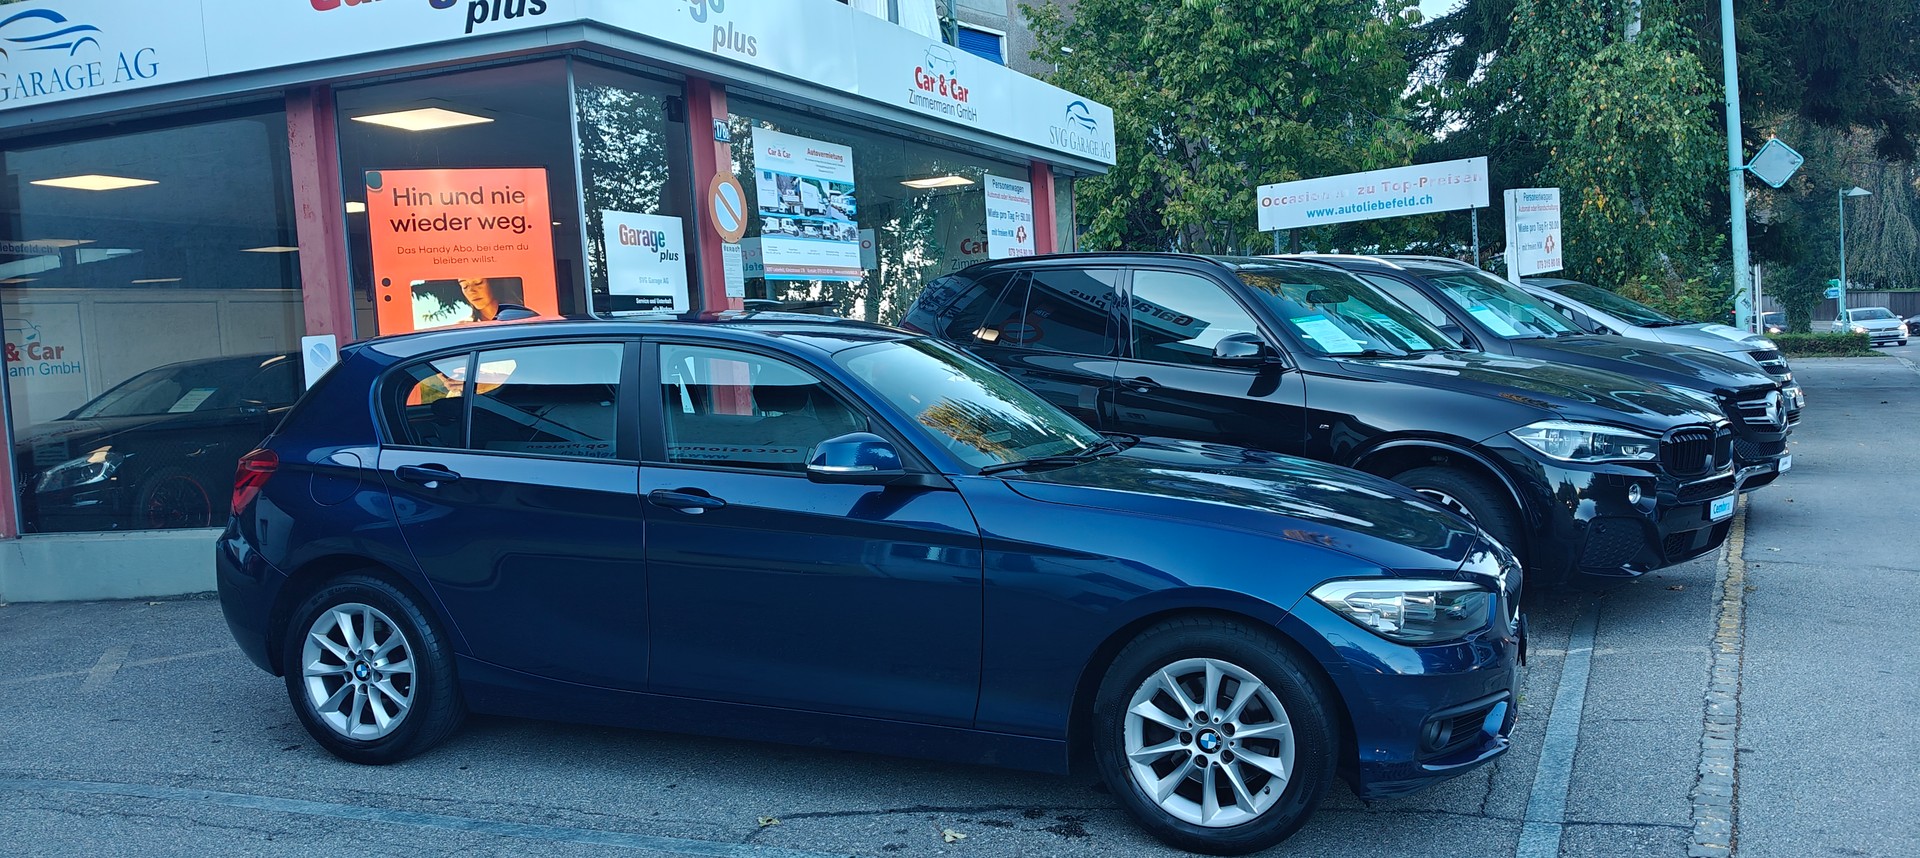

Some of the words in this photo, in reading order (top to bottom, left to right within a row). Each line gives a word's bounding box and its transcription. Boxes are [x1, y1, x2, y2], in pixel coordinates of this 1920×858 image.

[464, 0, 548, 34] plus
[712, 21, 757, 57] plus
[0, 62, 105, 101] GARAGE
[112, 47, 160, 83] AG
[915, 66, 936, 92] Car
[939, 74, 948, 97] &
[950, 78, 969, 103] Car
[908, 88, 956, 116] Zimmermann
[956, 103, 978, 123] GmbH
[1049, 125, 1068, 148] SVG
[1069, 131, 1100, 157] GARAGE
[1100, 141, 1111, 160] AG
[806, 147, 844, 163] Autovermietung
[392, 186, 433, 207] Hin
[439, 185, 484, 206] und
[491, 185, 526, 205] nie
[992, 178, 1025, 195] Personenwagen
[1357, 184, 1376, 197] zu
[1381, 173, 1483, 194] Top-Preisen
[1306, 194, 1433, 219] www.autoliebefeld.ch
[1523, 191, 1553, 203] Personenwagen
[390, 212, 473, 233] wieder
[477, 214, 533, 234] weg.
[1007, 211, 1015, 222] Tag
[1536, 222, 1544, 234] Tag
[397, 246, 416, 255] Das
[418, 245, 451, 256] Handy
[452, 244, 475, 254] Abo,
[476, 243, 492, 252] bei
[493, 243, 515, 252] dem
[516, 242, 529, 251] du
[618, 223, 666, 253] Garage
[659, 249, 679, 263] plus
[960, 237, 989, 255] Car
[433, 256, 469, 265] bleiben
[471, 255, 498, 264] willst.
[5, 342, 21, 362] &
[27, 341, 65, 361] Car
[39, 361, 81, 376] GmbH
